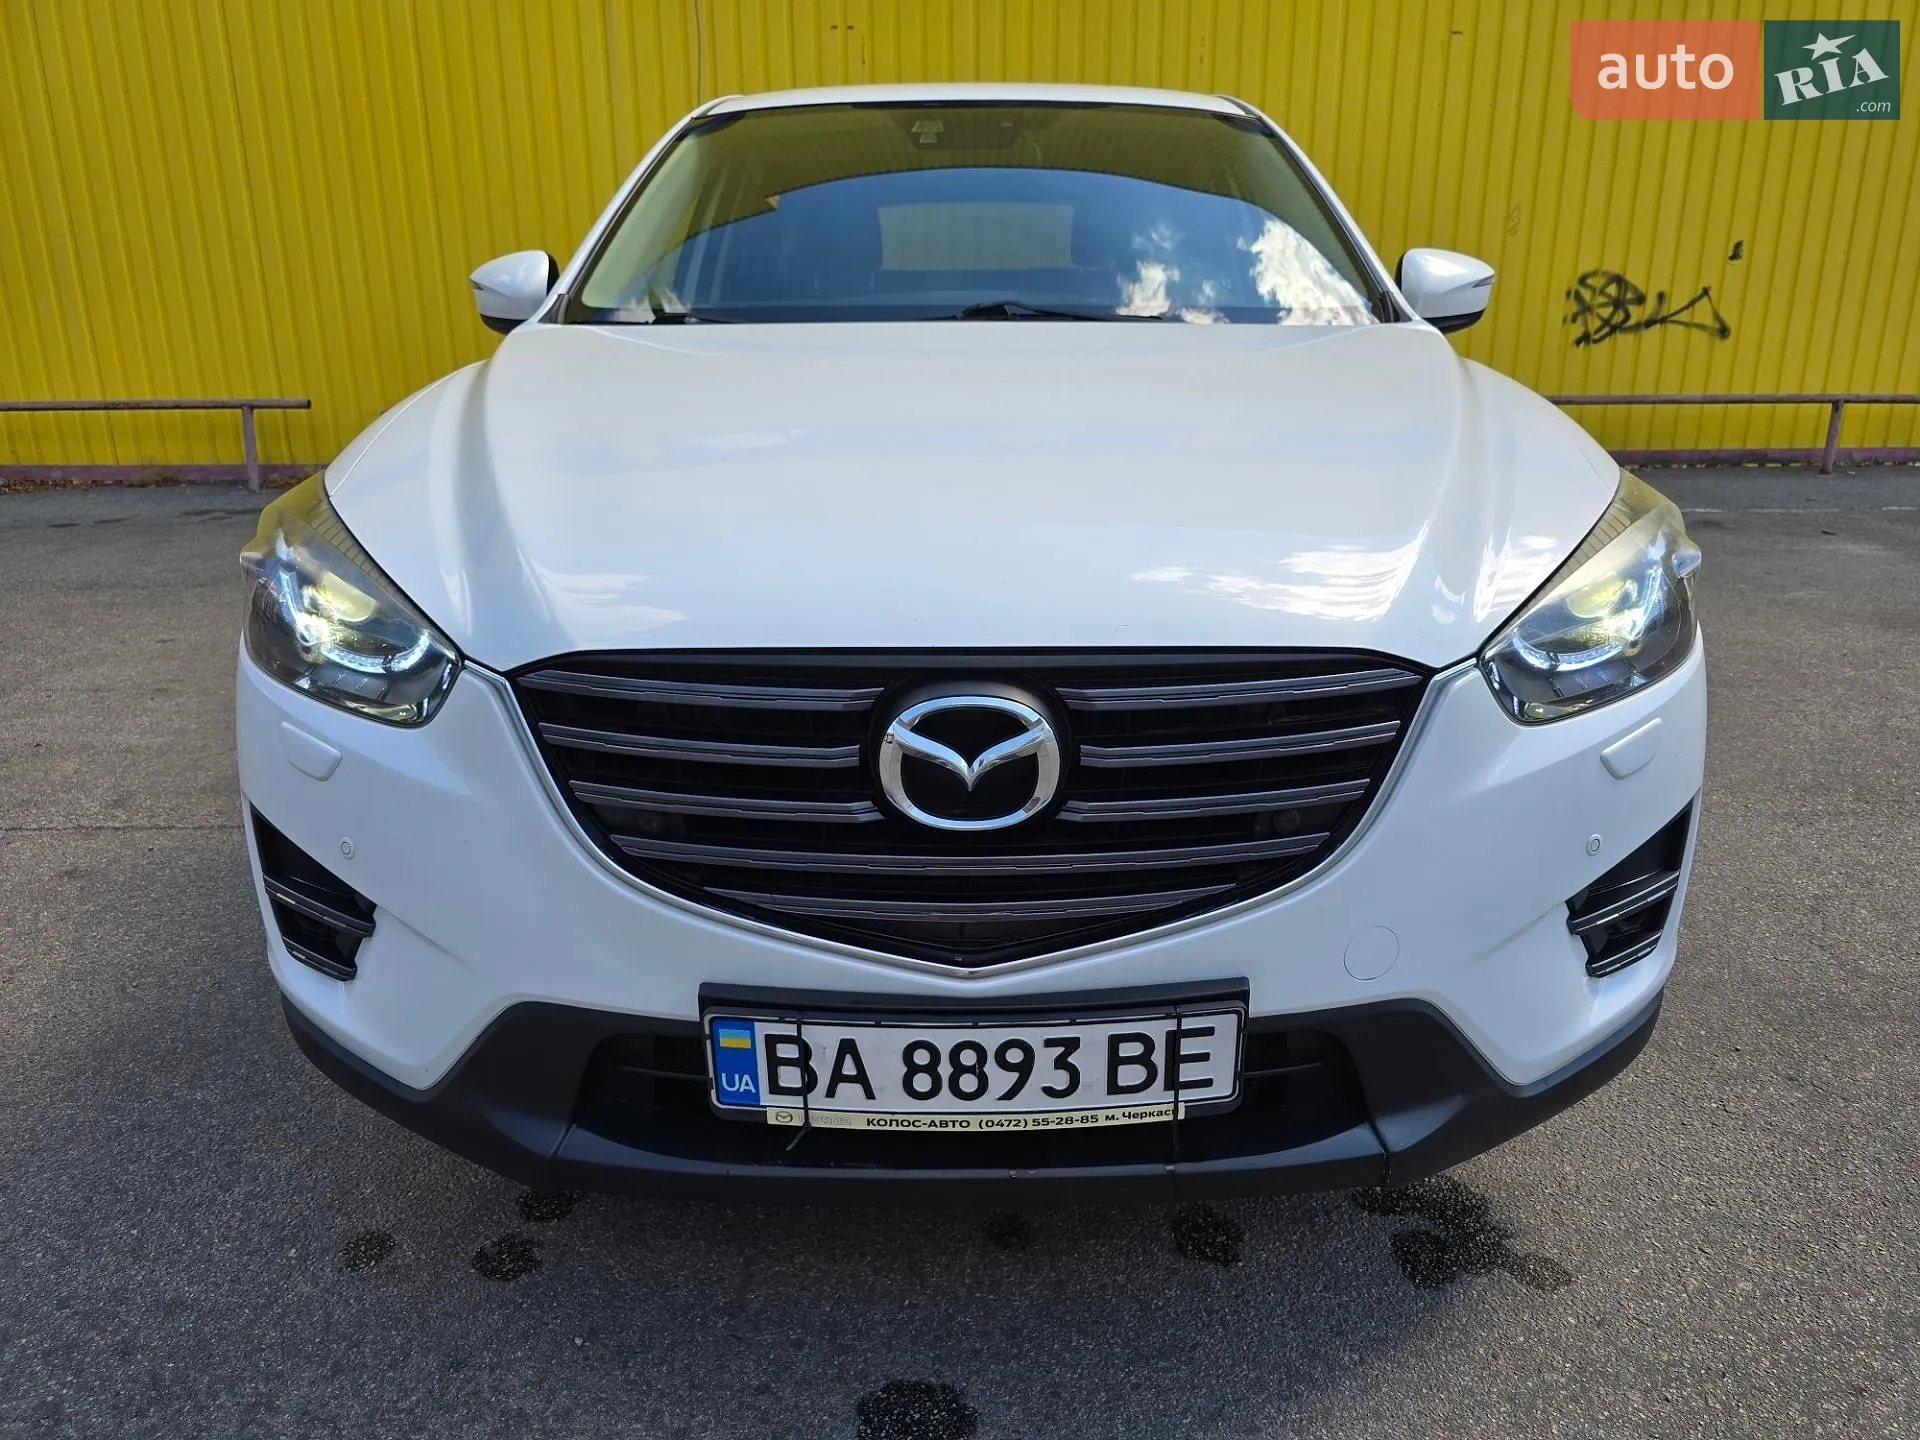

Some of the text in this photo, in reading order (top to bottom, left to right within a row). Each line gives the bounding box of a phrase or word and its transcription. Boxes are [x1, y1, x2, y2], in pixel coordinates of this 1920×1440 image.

[764, 1026, 1216, 1101] BA 8893 BE
[721, 1073, 756, 1093] UA
[866, 1117, 971, 1129] КОЛОС-АВТО
[978, 1119, 1028, 1129] (0472)
[1032, 1114, 1099, 1127] 55-28-85
